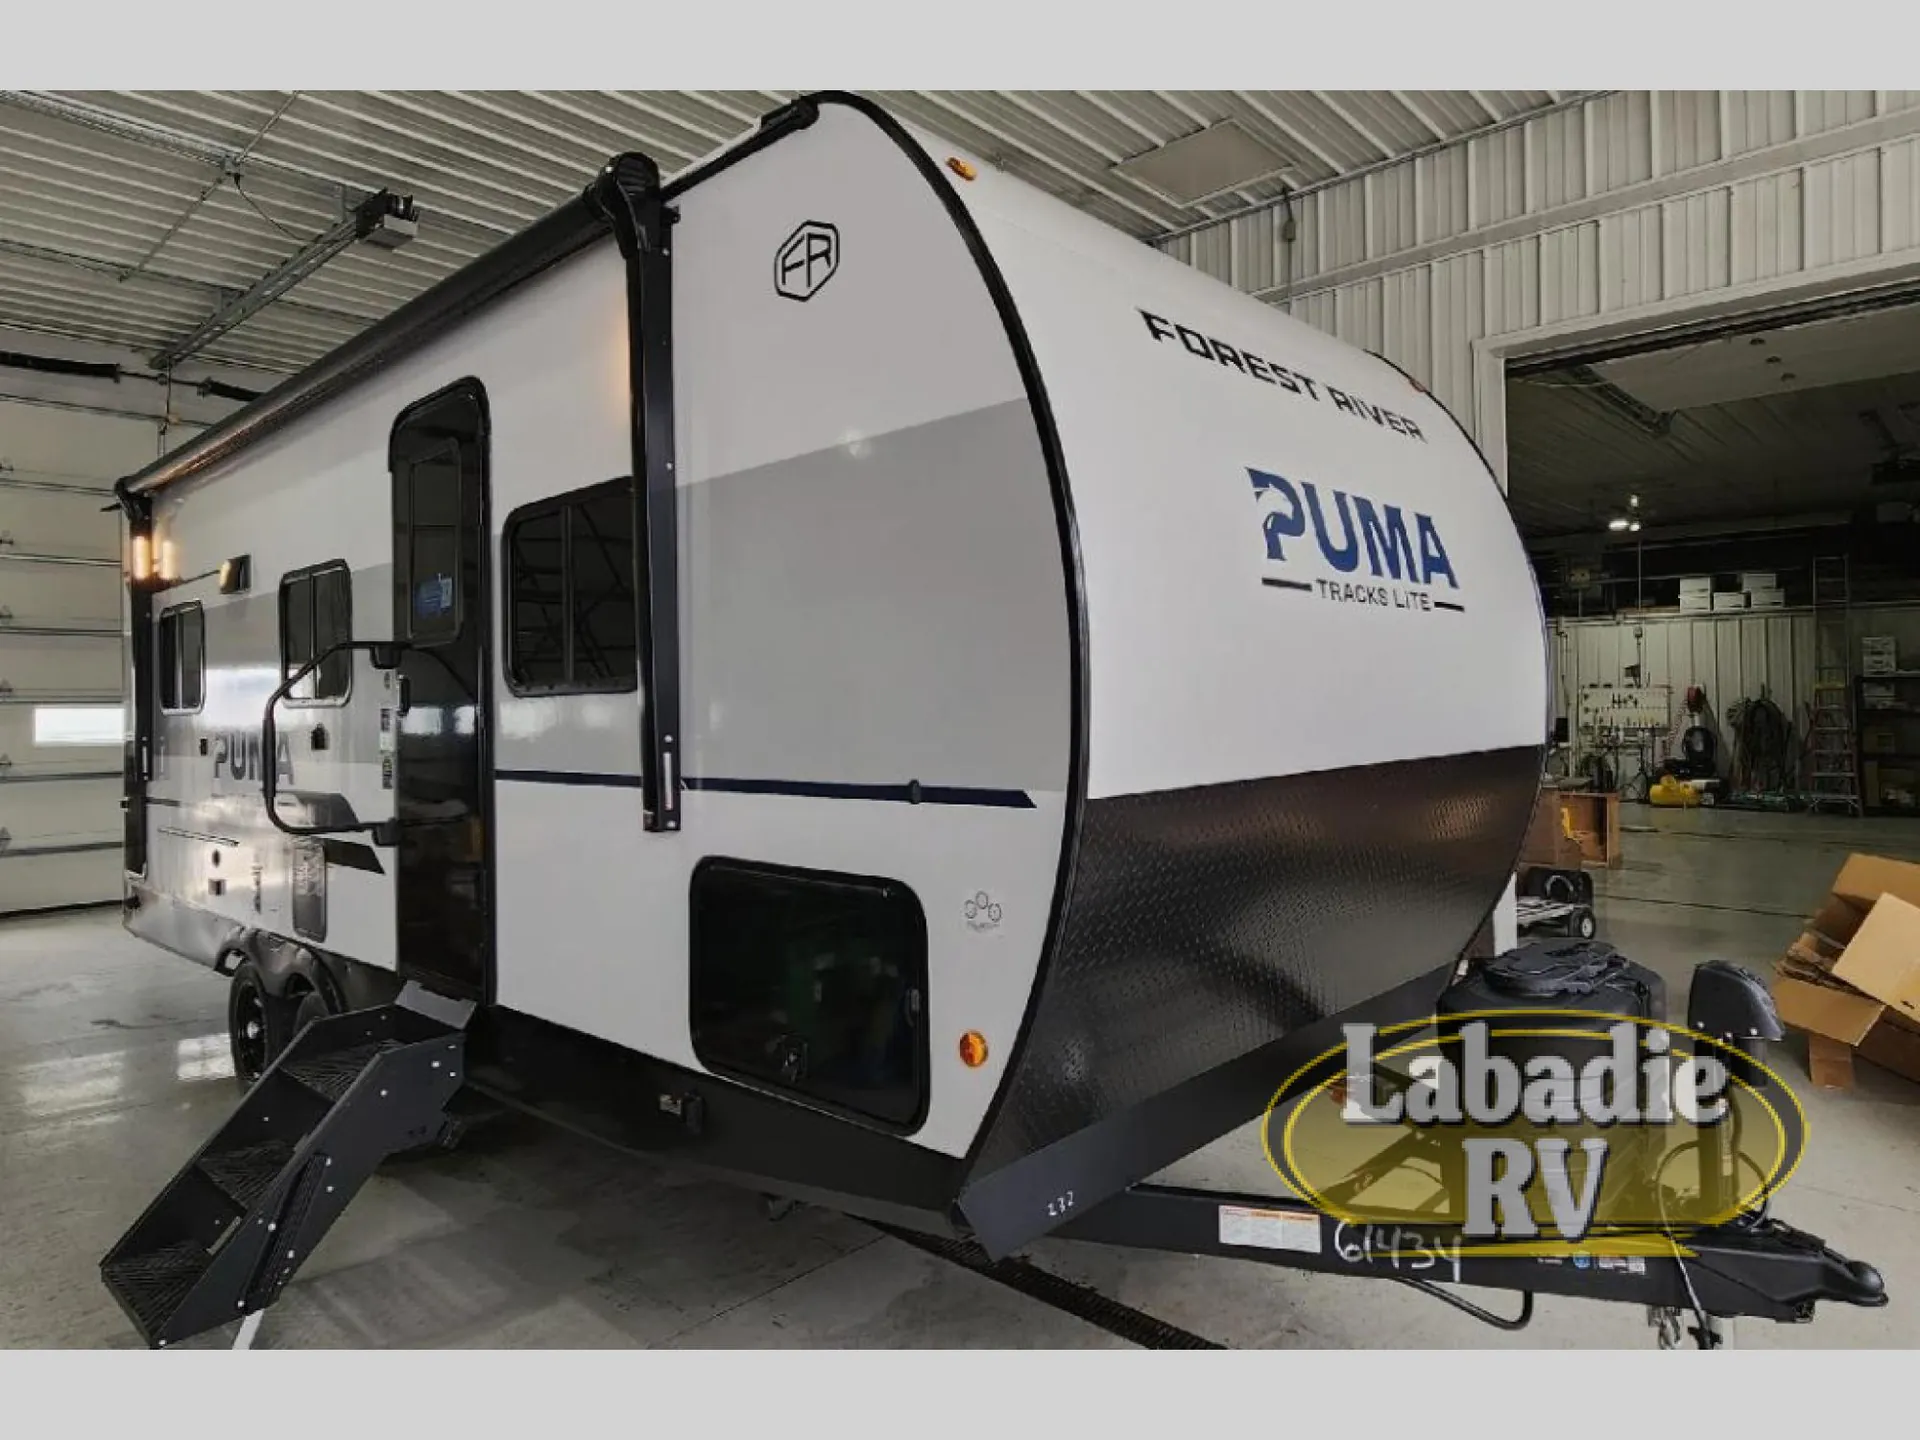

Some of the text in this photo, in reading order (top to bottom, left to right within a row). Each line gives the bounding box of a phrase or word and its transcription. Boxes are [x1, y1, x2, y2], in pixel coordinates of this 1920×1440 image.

[1138, 308, 1427, 443] FOREST RIVER
[1245, 467, 1459, 589] PUMA
[1315, 579, 1431, 611] TRACKS LITE
[1334, 1219, 1463, 1283] 61434
